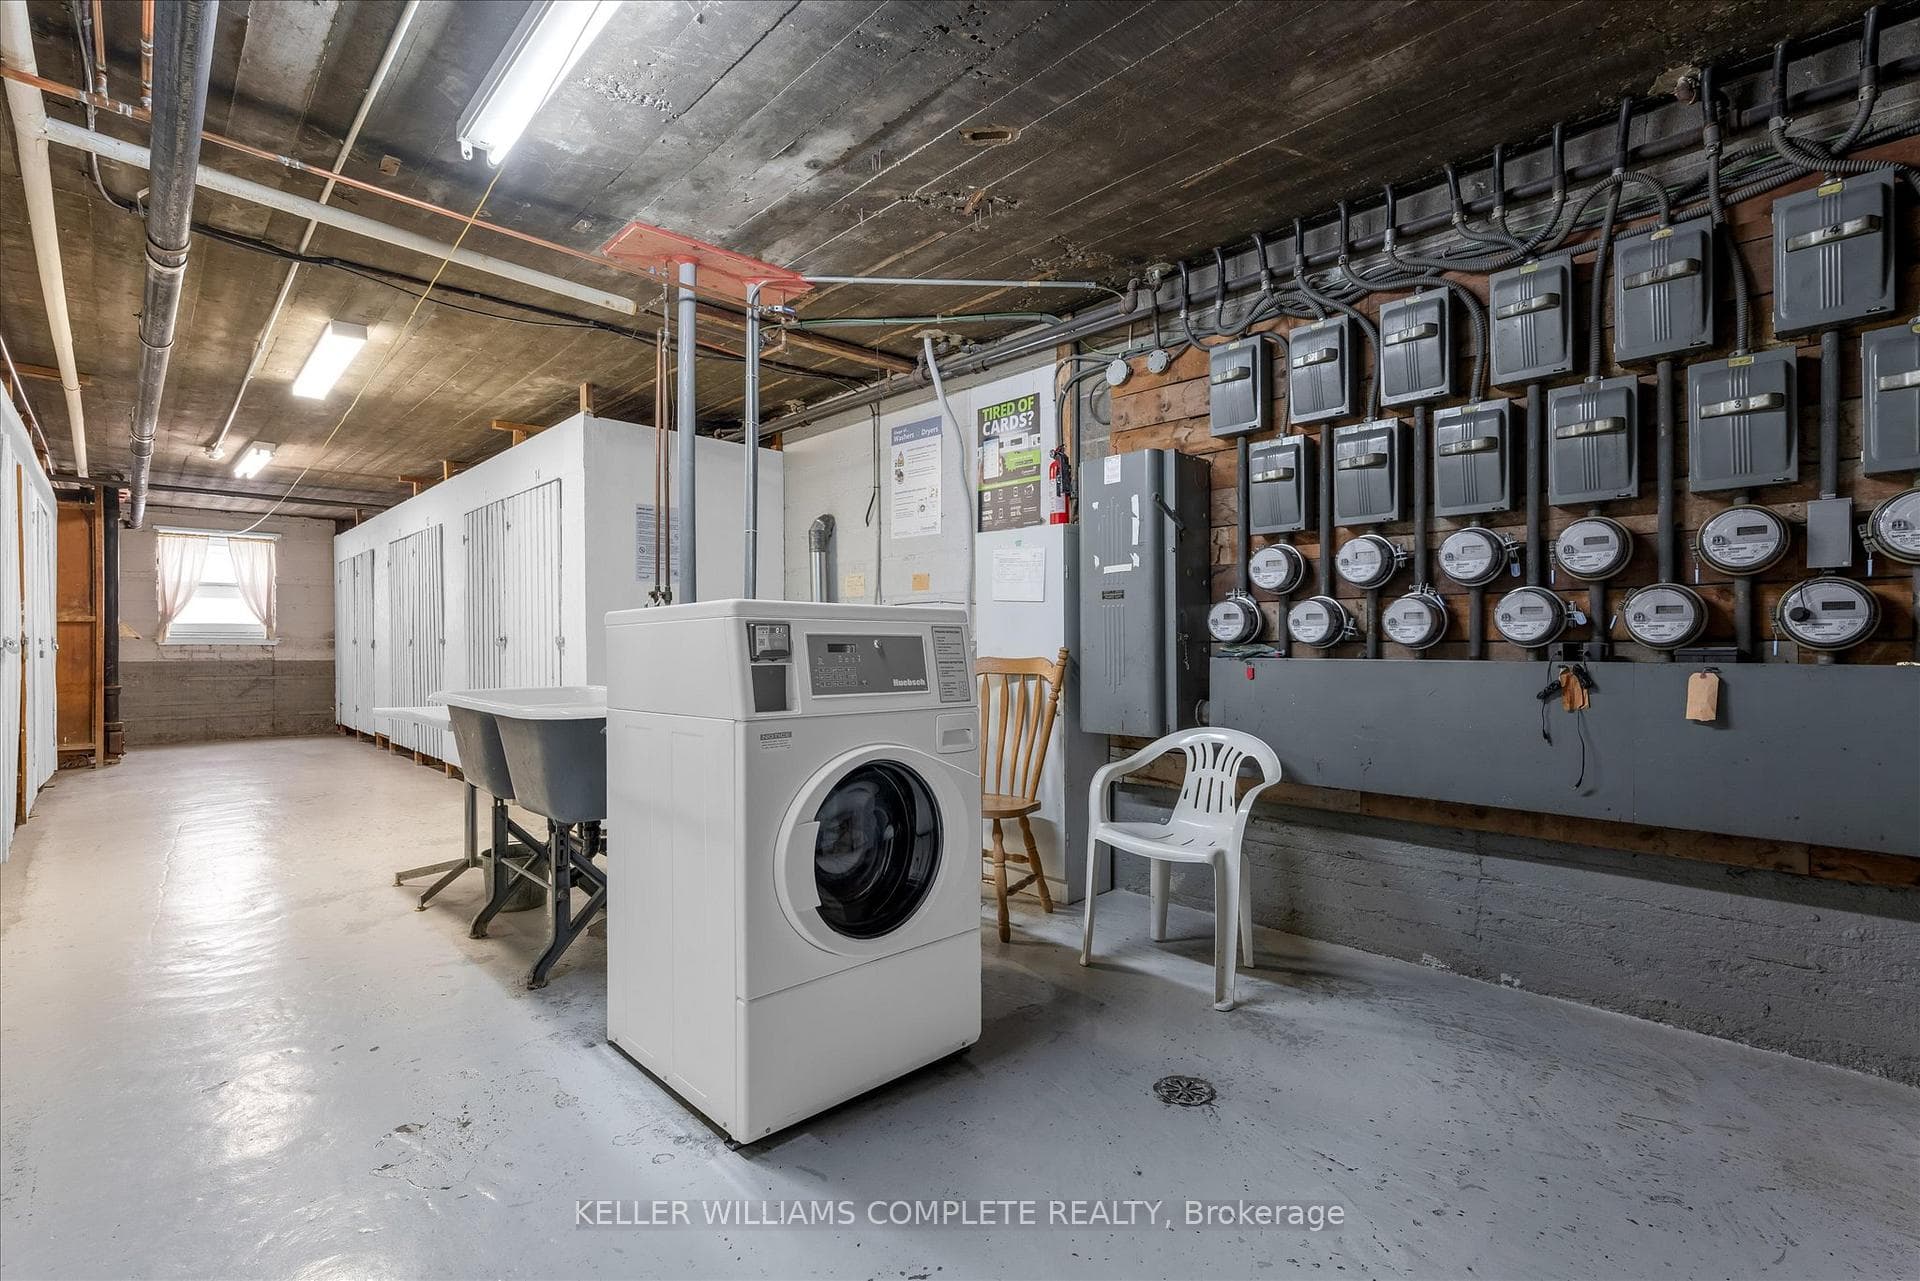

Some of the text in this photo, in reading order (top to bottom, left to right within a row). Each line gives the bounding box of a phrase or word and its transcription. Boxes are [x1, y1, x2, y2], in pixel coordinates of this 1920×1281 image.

[982, 396, 1035, 422] TIRED OF
[1734, 400, 1742, 409] 3
[982, 410, 1035, 437] CARDS?
[892, 678, 926, 687] Huebsch
